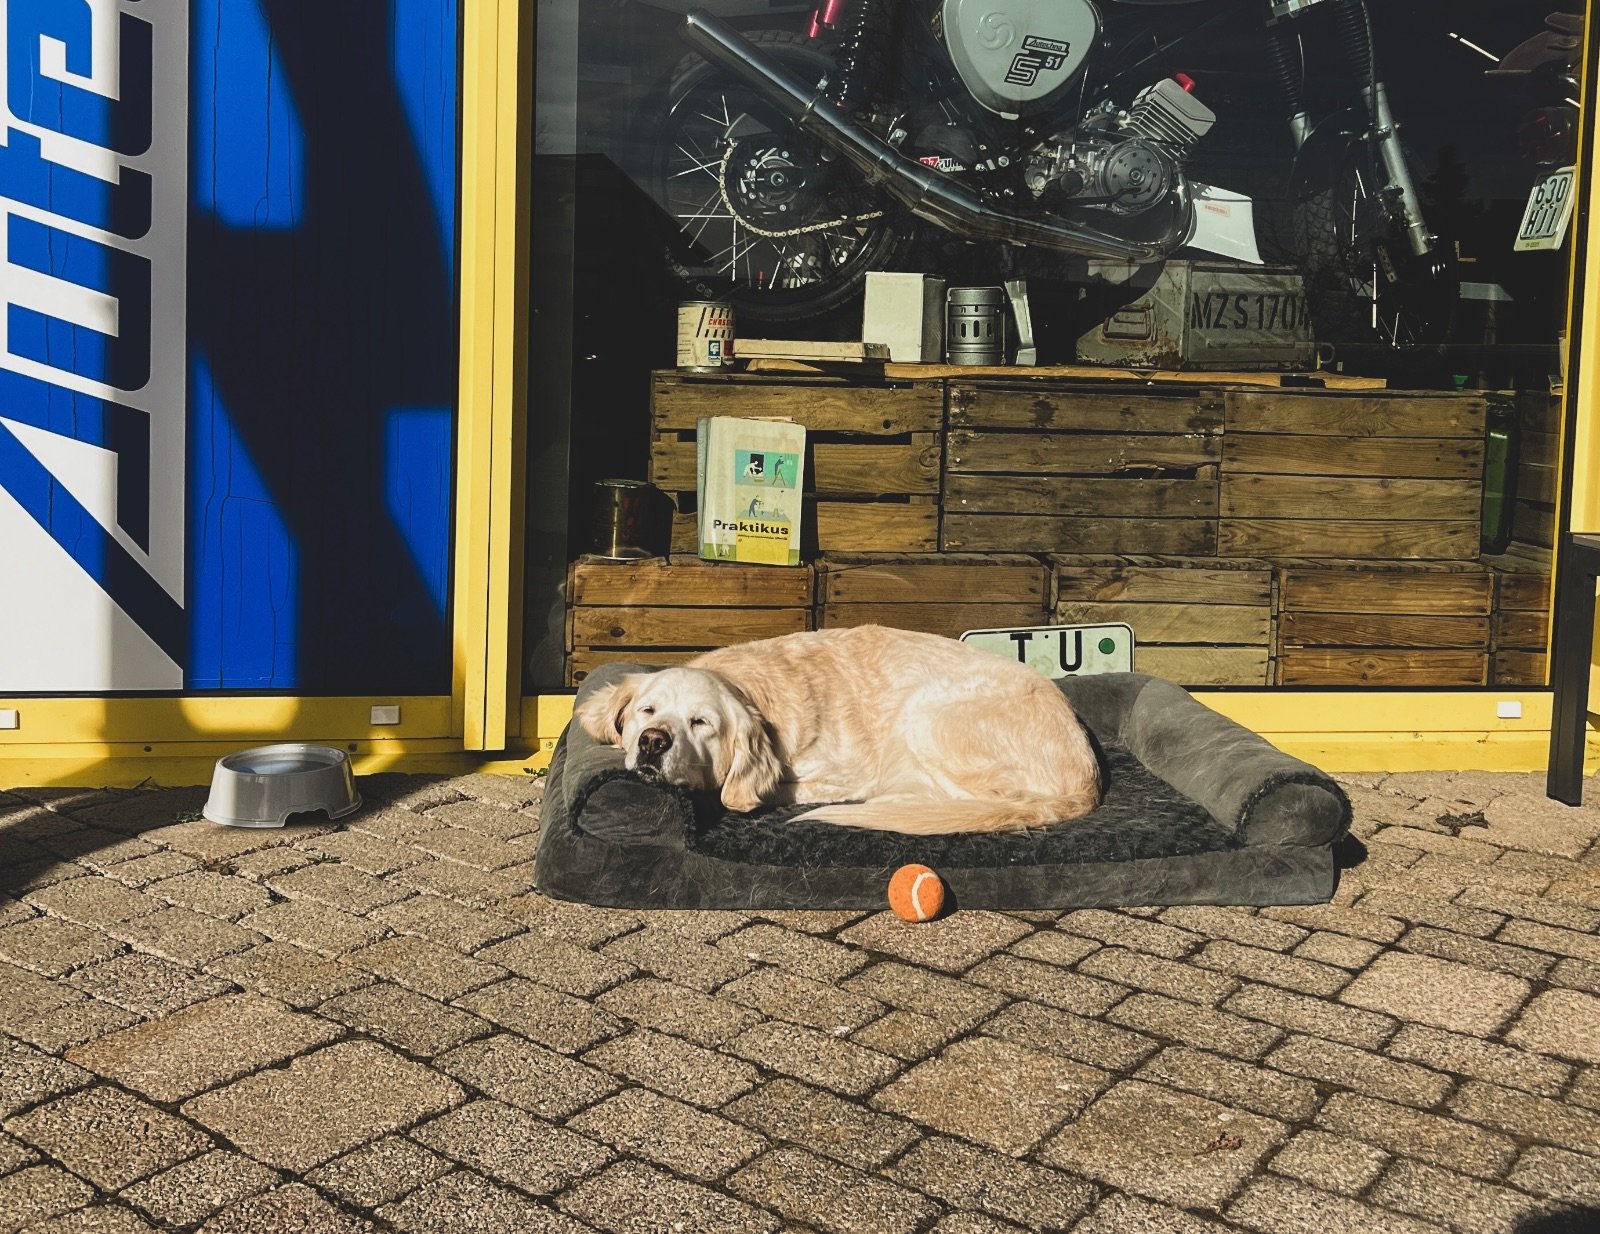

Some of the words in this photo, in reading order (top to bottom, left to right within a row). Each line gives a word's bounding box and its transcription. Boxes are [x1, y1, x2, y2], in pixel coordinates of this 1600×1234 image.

[1045, 56, 1062, 69] 51
[1535, 177, 1568, 205] 630
[713, 519, 789, 535] Praktikus
